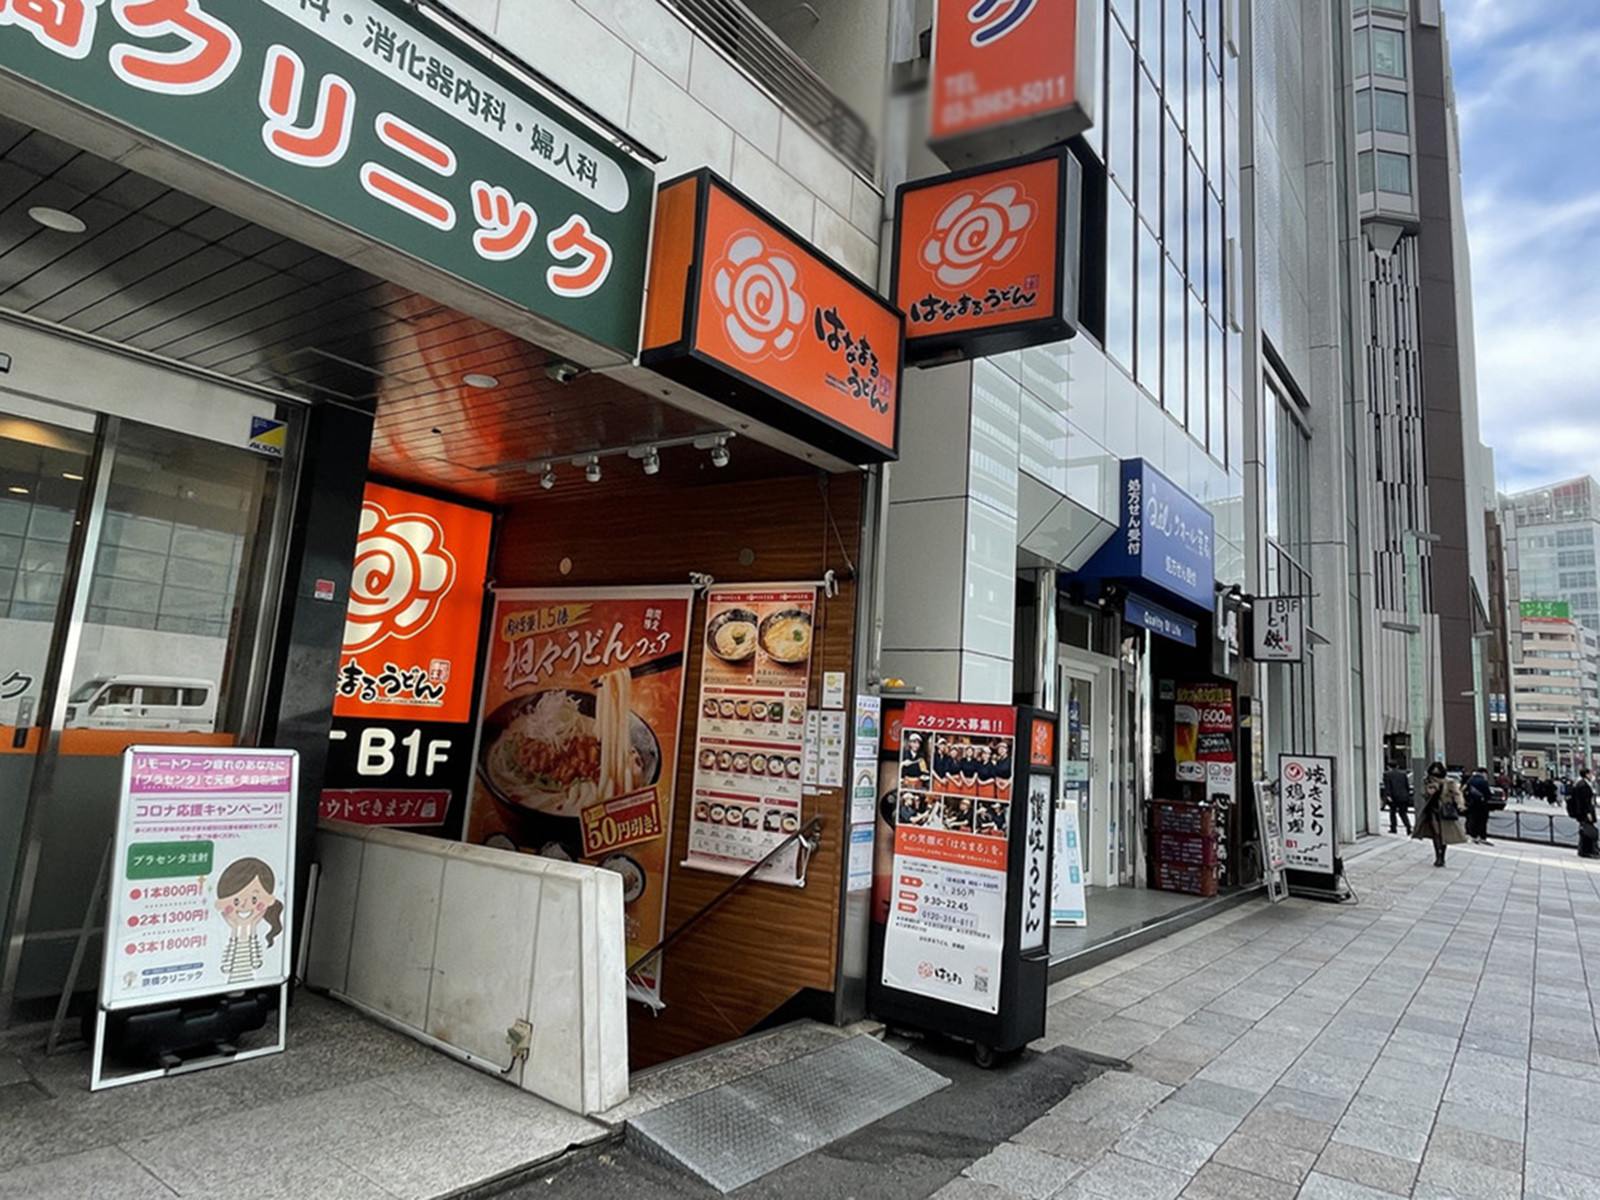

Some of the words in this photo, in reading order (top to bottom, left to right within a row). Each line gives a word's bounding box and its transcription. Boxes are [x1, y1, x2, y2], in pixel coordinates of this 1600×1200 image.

[910, 285, 1037, 322] はなまるうどん
[814, 306, 879, 378] はなまる
[846, 366, 888, 414] うどん
[1128, 479, 1140, 556] 処方せん受付
[1276, 600, 1298, 613] B1F
[336, 657, 445, 702] まるうどん
[917, 715, 1003, 732] スタッフ大募集!!
[357, 727, 452, 777] B1F
[136, 803, 283, 817] コロナ応援キャンペーン!!
[319, 799, 421, 819] ウトできます!
[1305, 764, 1329, 837] 焼きとり
[133, 853, 209, 866] プラセンタ注射
